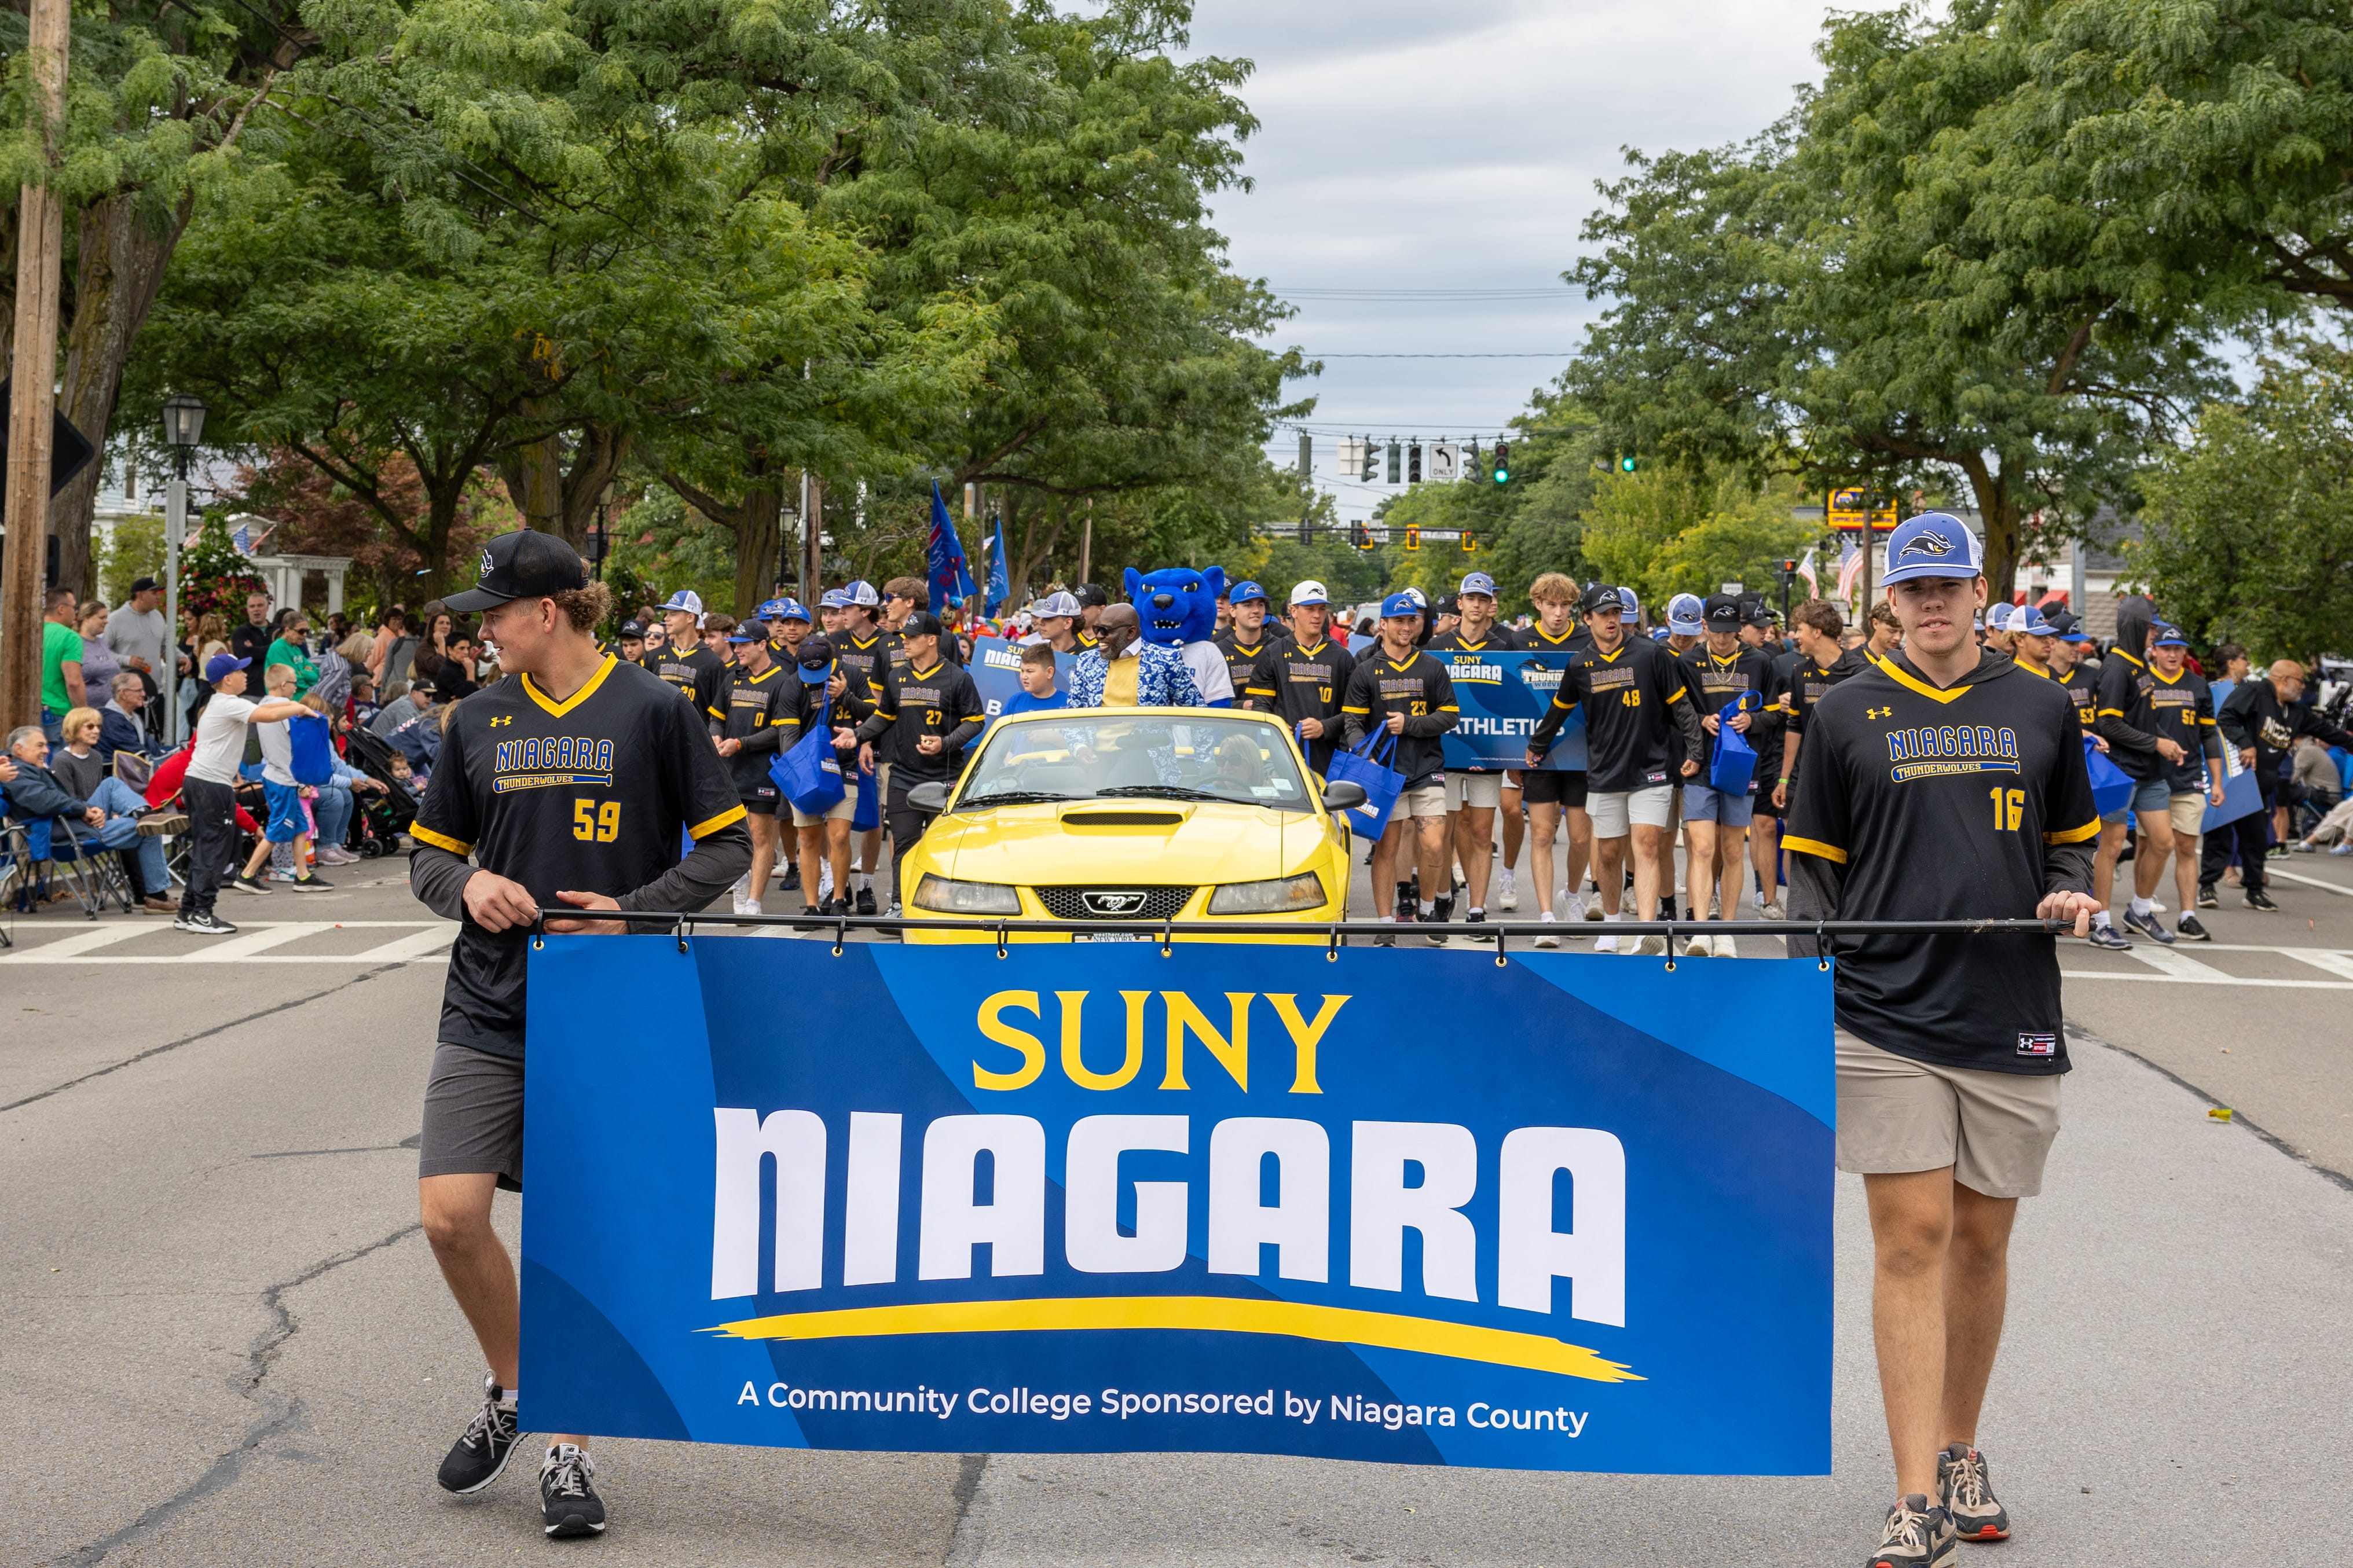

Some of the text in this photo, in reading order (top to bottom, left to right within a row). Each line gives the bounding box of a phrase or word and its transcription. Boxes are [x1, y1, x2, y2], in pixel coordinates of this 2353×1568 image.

[1006, 645, 1026, 656] SUN
[842, 654, 874, 667] NIAGAR
[984, 649, 1021, 668] NIAG
[1454, 656, 1482, 664] SUNY
[659, 663, 697, 679] NIAGARA
[1230, 664, 1254, 678] NIAG
[1288, 662, 1332, 677] NIAGARA
[1447, 665, 1502, 681] AGARA
[1523, 671, 1564, 682] THUND
[1590, 667, 1634, 685] NIAGARA
[1379, 678, 1423, 692] NIAGARA
[1702, 673, 1749, 686] NIAGARA
[731, 689, 769, 703] NIAGARA
[900, 687, 941, 701] NIAGARA
[1319, 686, 1332, 703] 10
[1805, 683, 1834, 696] NIAG
[1622, 690, 1640, 707] 48
[986, 699, 1002, 716] B
[1411, 701, 1427, 716] 23
[754, 713, 764, 727] 0
[926, 710, 942, 725] 27
[2080, 708, 2094, 723] 53
[1886, 726, 2019, 762] NIAGARA
[495, 737, 614, 772] NIAGARA
[1897, 763, 1981, 779] THUNDERWOLVES
[497, 776, 574, 791] THUNDERWOLVES
[1990, 787, 2025, 831] 16
[573, 798, 621, 843] 59
[973, 990, 1353, 1093] SUNY
[712, 1108, 1626, 1327] NIAGARA
[737, 1381, 1589, 1438] A Community College Sponsored by Niagara County
